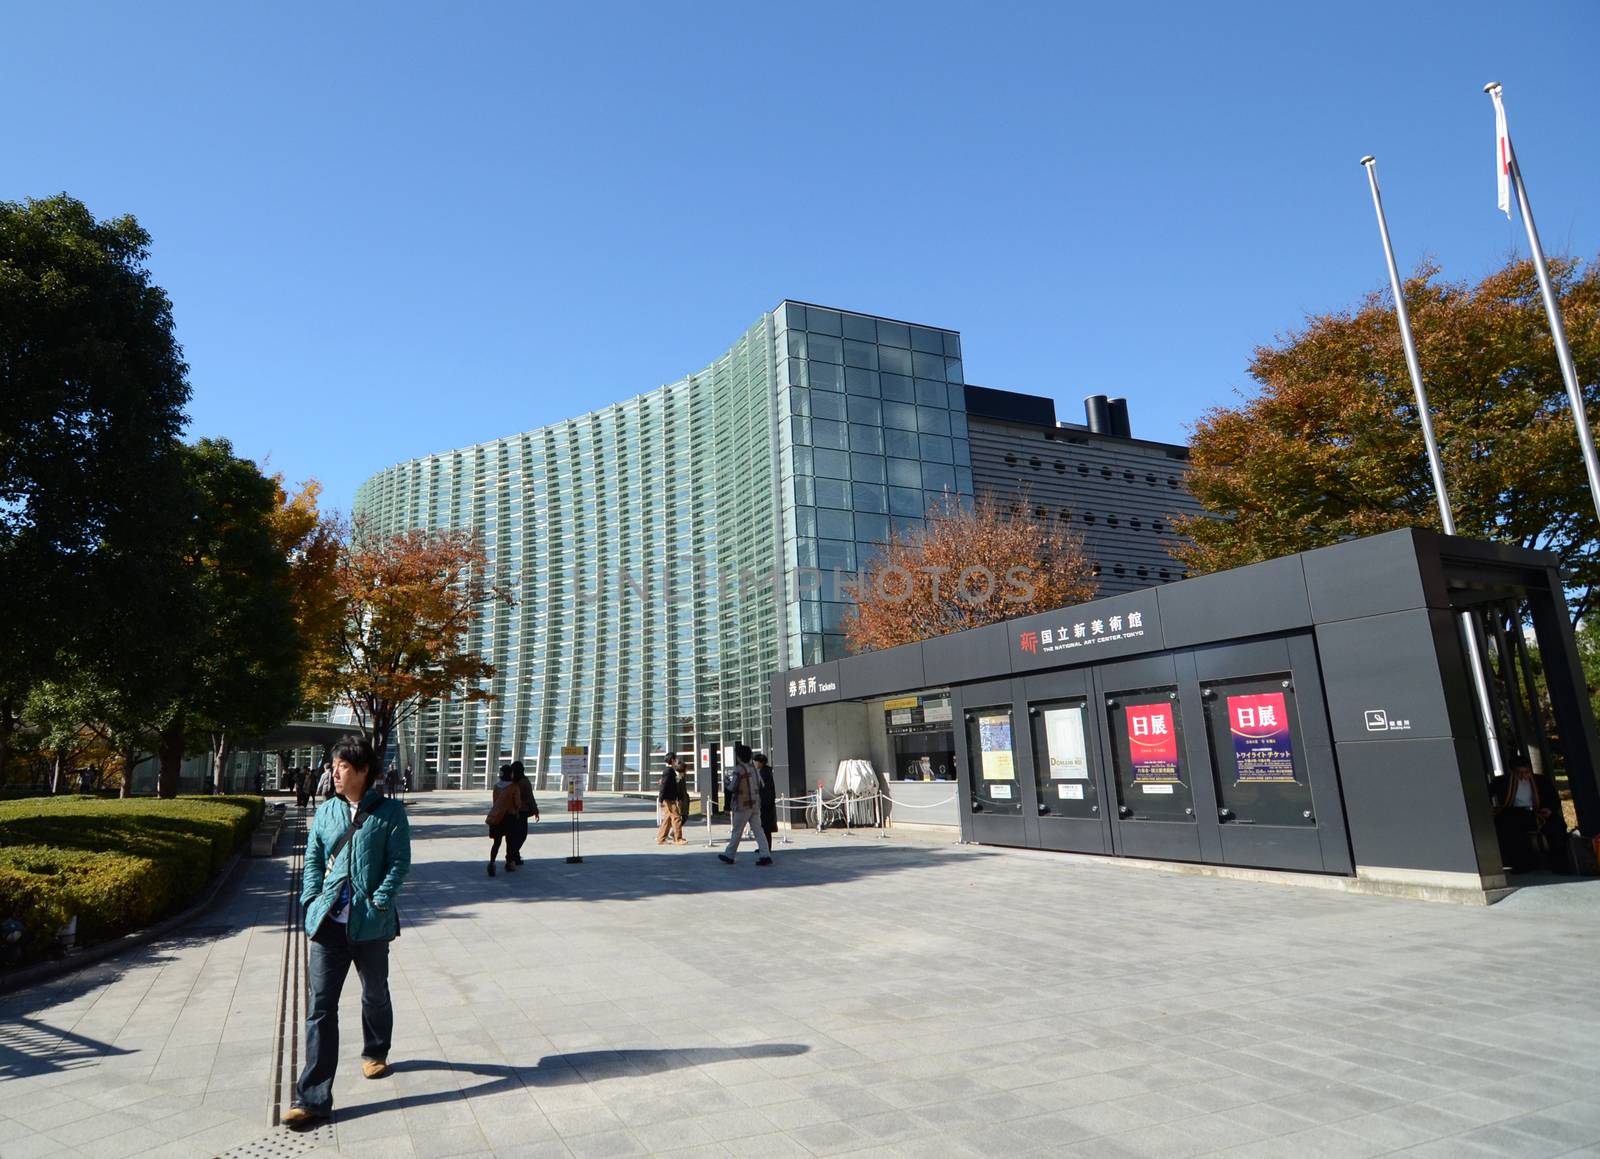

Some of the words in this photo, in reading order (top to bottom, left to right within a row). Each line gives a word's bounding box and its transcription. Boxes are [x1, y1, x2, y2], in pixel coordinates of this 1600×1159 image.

[1041, 611, 1143, 644] 国立新美術館
[1054, 641, 1082, 650] NATIONAL
[1123, 630, 1144, 638] TOKYO
[789, 676, 817, 697] 券売所
[818, 682, 836, 692] Tickets
[1132, 714, 1168, 736] 日展
[1237, 705, 1278, 728] 日展
